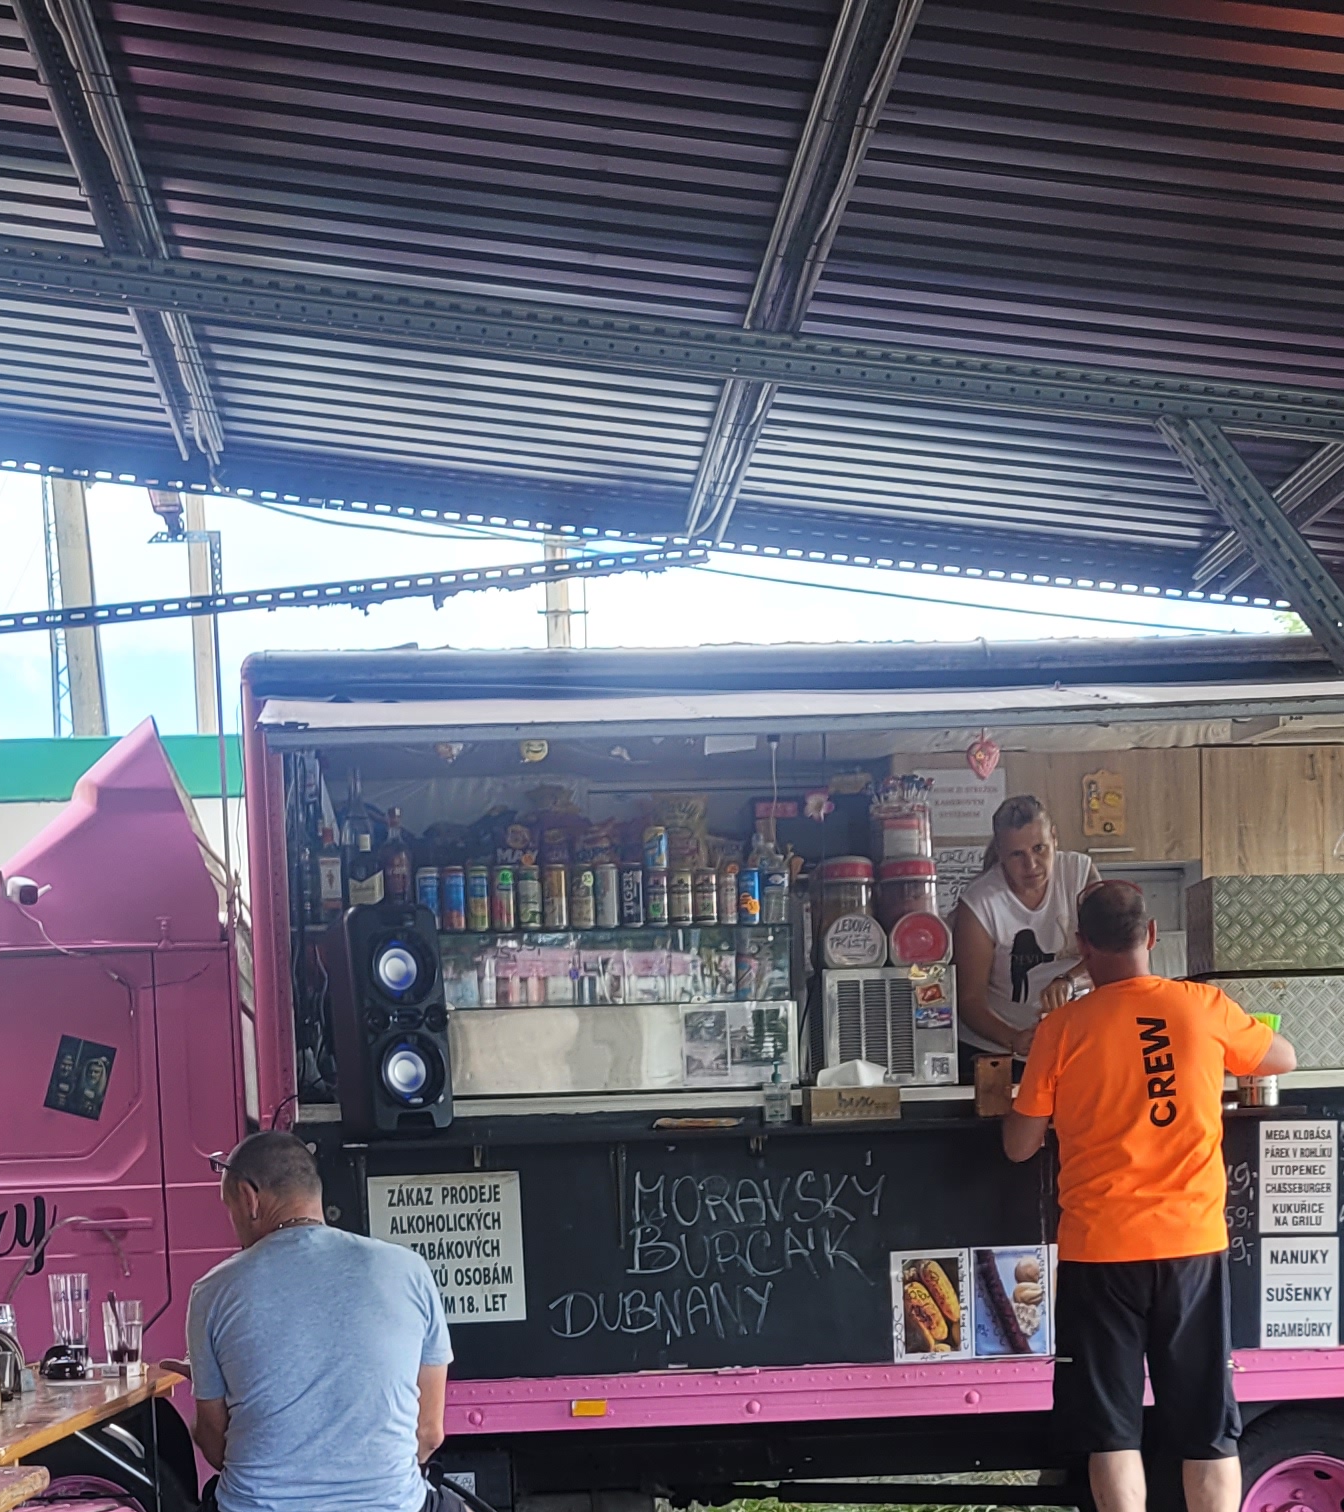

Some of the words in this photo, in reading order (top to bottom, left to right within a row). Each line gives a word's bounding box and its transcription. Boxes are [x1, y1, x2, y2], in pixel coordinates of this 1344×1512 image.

[1136, 1016, 1177, 1128] CREW
[1265, 1129, 1291, 1141] MEGA
[1293, 1126, 1333, 1141] KLOBÁSA
[1265, 1144, 1290, 1158] PÁREK
[1292, 1147, 1299, 1158] V
[1299, 1144, 1333, 1158] ROHLÍKU
[1271, 1164, 1326, 1176] UTOPENEC
[387, 1184, 434, 1208] ZÁKAZ
[441, 1183, 501, 1205] PRODEJE
[1265, 1182, 1333, 1194] CHASSEBURGER
[1272, 1200, 1325, 1214] KUKUŘICE
[390, 1208, 502, 1235] ALKOHOLICKÝCH
[1274, 1216, 1289, 1226] NA
[1292, 1215, 1322, 1226] GRILU
[410, 1235, 501, 1261] TABÁKOVÝCH
[1269, 1249, 1329, 1265] NANUKY
[454, 1262, 513, 1287] OSOBÁM
[1266, 1283, 1333, 1302] SUŠENKY
[459, 1295, 480, 1314] 18.
[484, 1293, 508, 1313] LET
[1266, 1317, 1333, 1338] BRAMBŮRKY
